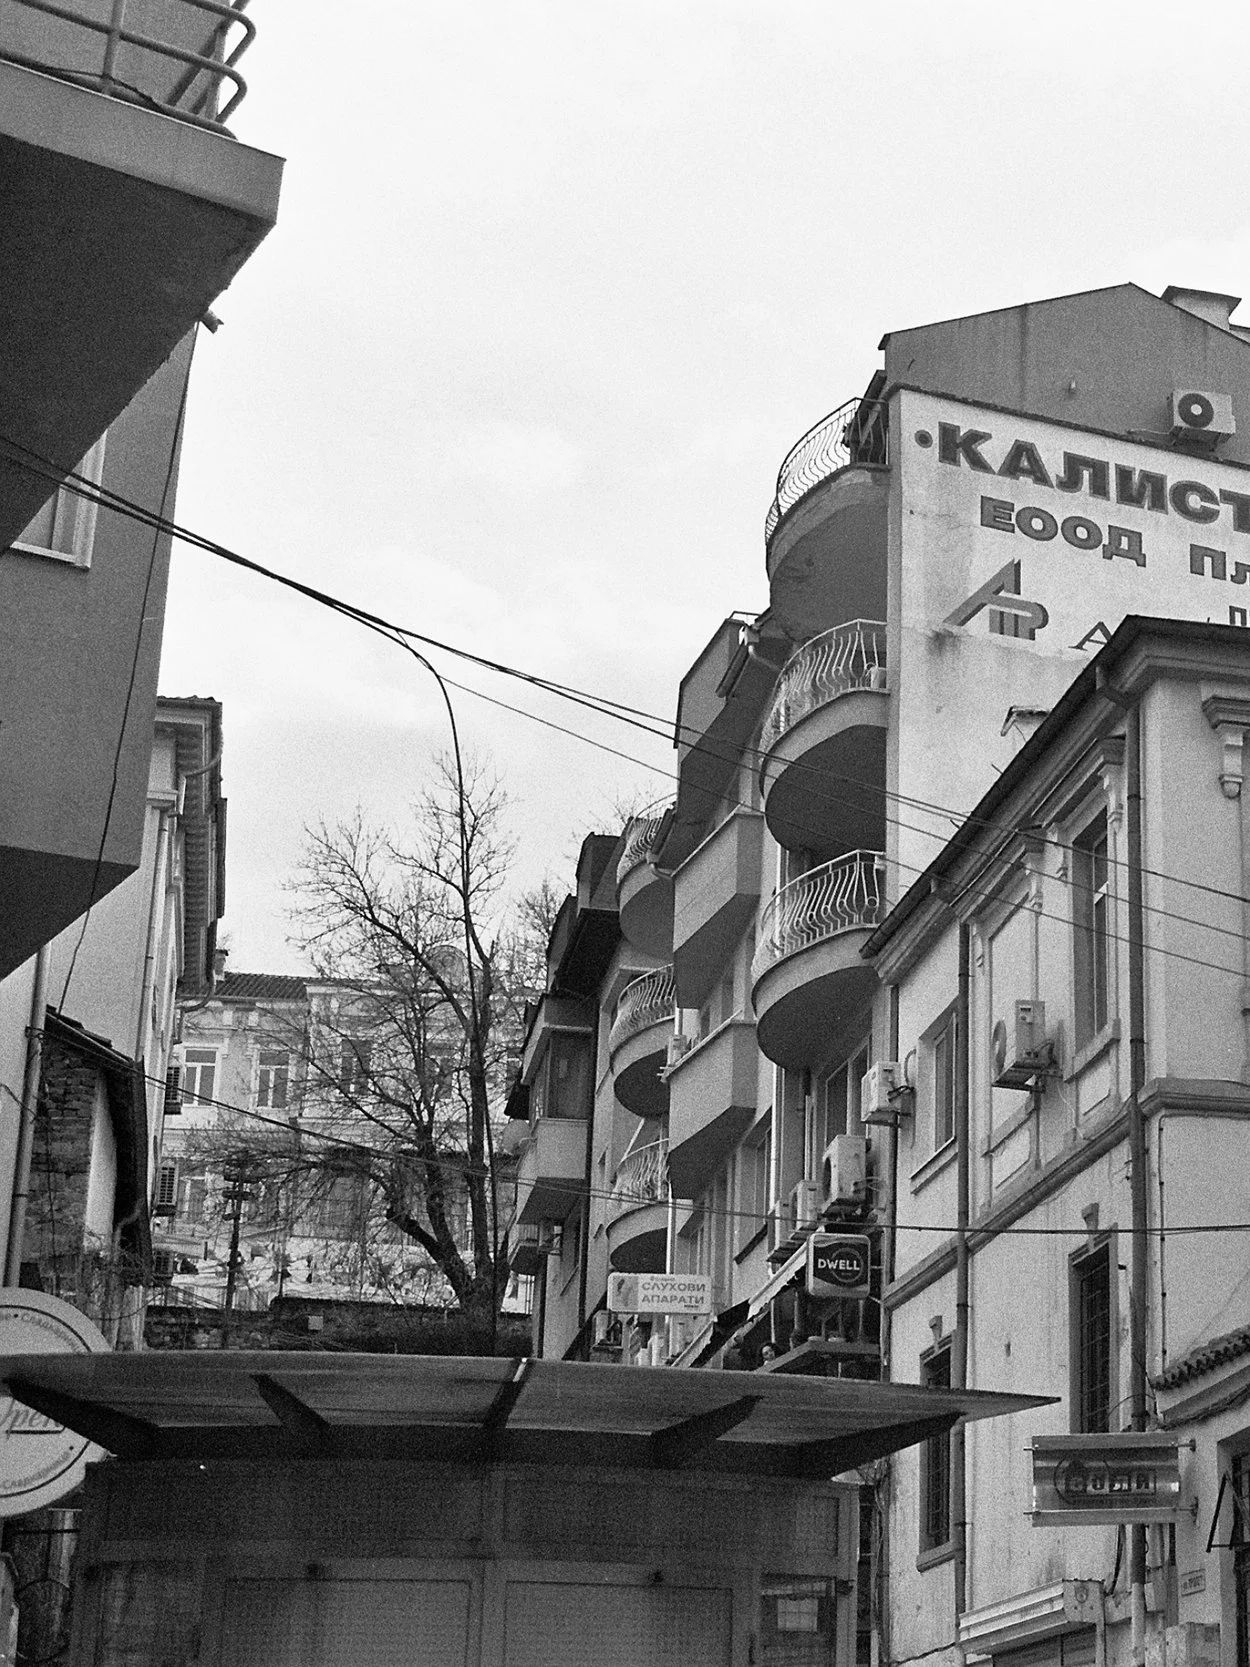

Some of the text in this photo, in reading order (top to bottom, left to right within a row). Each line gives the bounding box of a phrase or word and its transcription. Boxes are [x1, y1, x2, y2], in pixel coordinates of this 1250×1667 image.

[980, 495, 1147, 568] ЕООД
[817, 1258, 861, 1271] DWELL
[641, 1282, 706, 1292] СЛУХОВИ
[641, 1294, 705, 1305] АПАРАТИ
